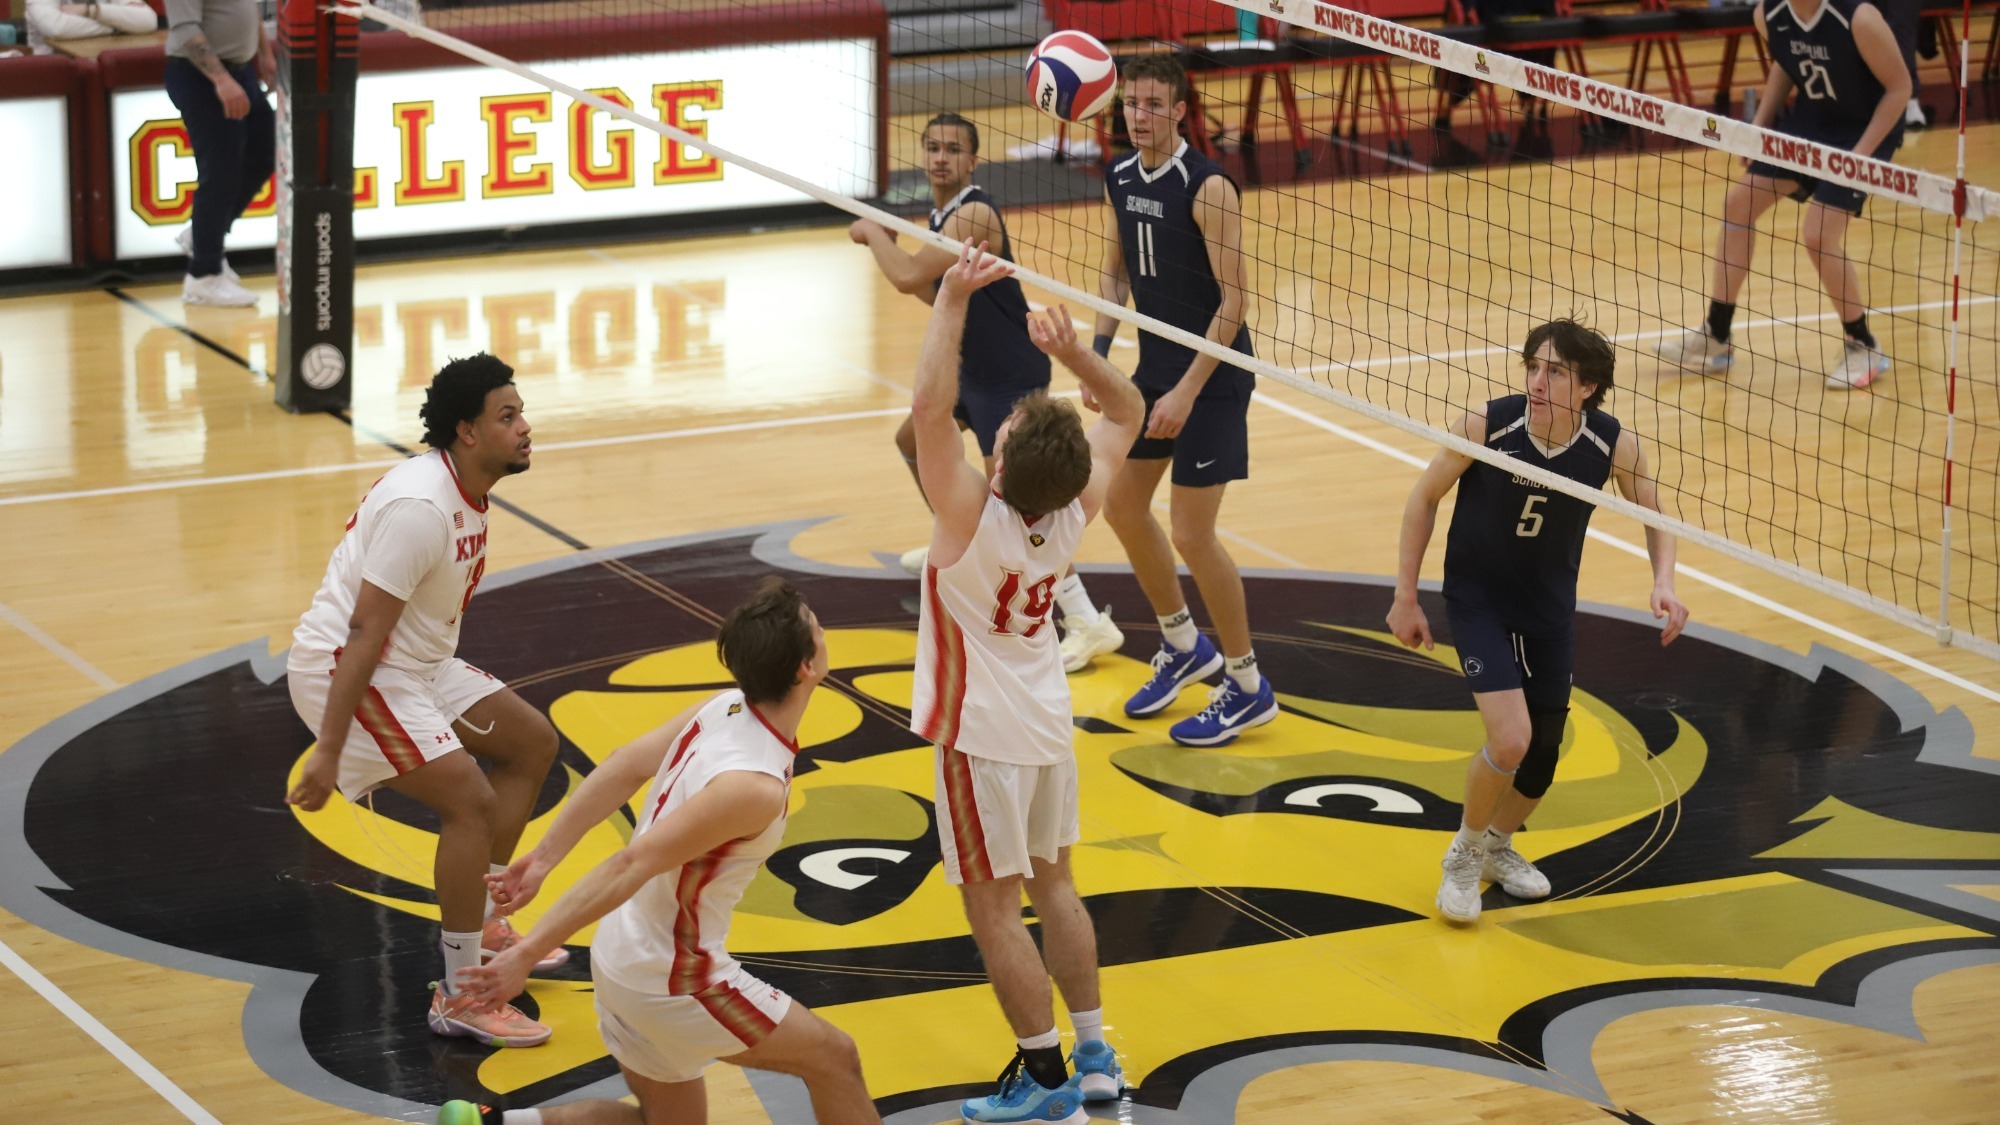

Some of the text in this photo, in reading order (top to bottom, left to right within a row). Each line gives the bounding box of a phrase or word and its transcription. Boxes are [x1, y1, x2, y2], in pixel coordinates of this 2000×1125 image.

[1314, 5, 1441, 60] KING'S COLLEGE
[1524, 65, 1665, 126] KING'S COLLEGE
[1799, 59, 1837, 100] 21
[129, 79, 724, 226] CLEGE
[1761, 132, 1918, 198] KING'S COLLEGE
[314, 212, 333, 332] sports imports
[1137, 221, 1157, 277] 11
[1516, 494, 1548, 537] 5
[989, 565, 1058, 639] 19
